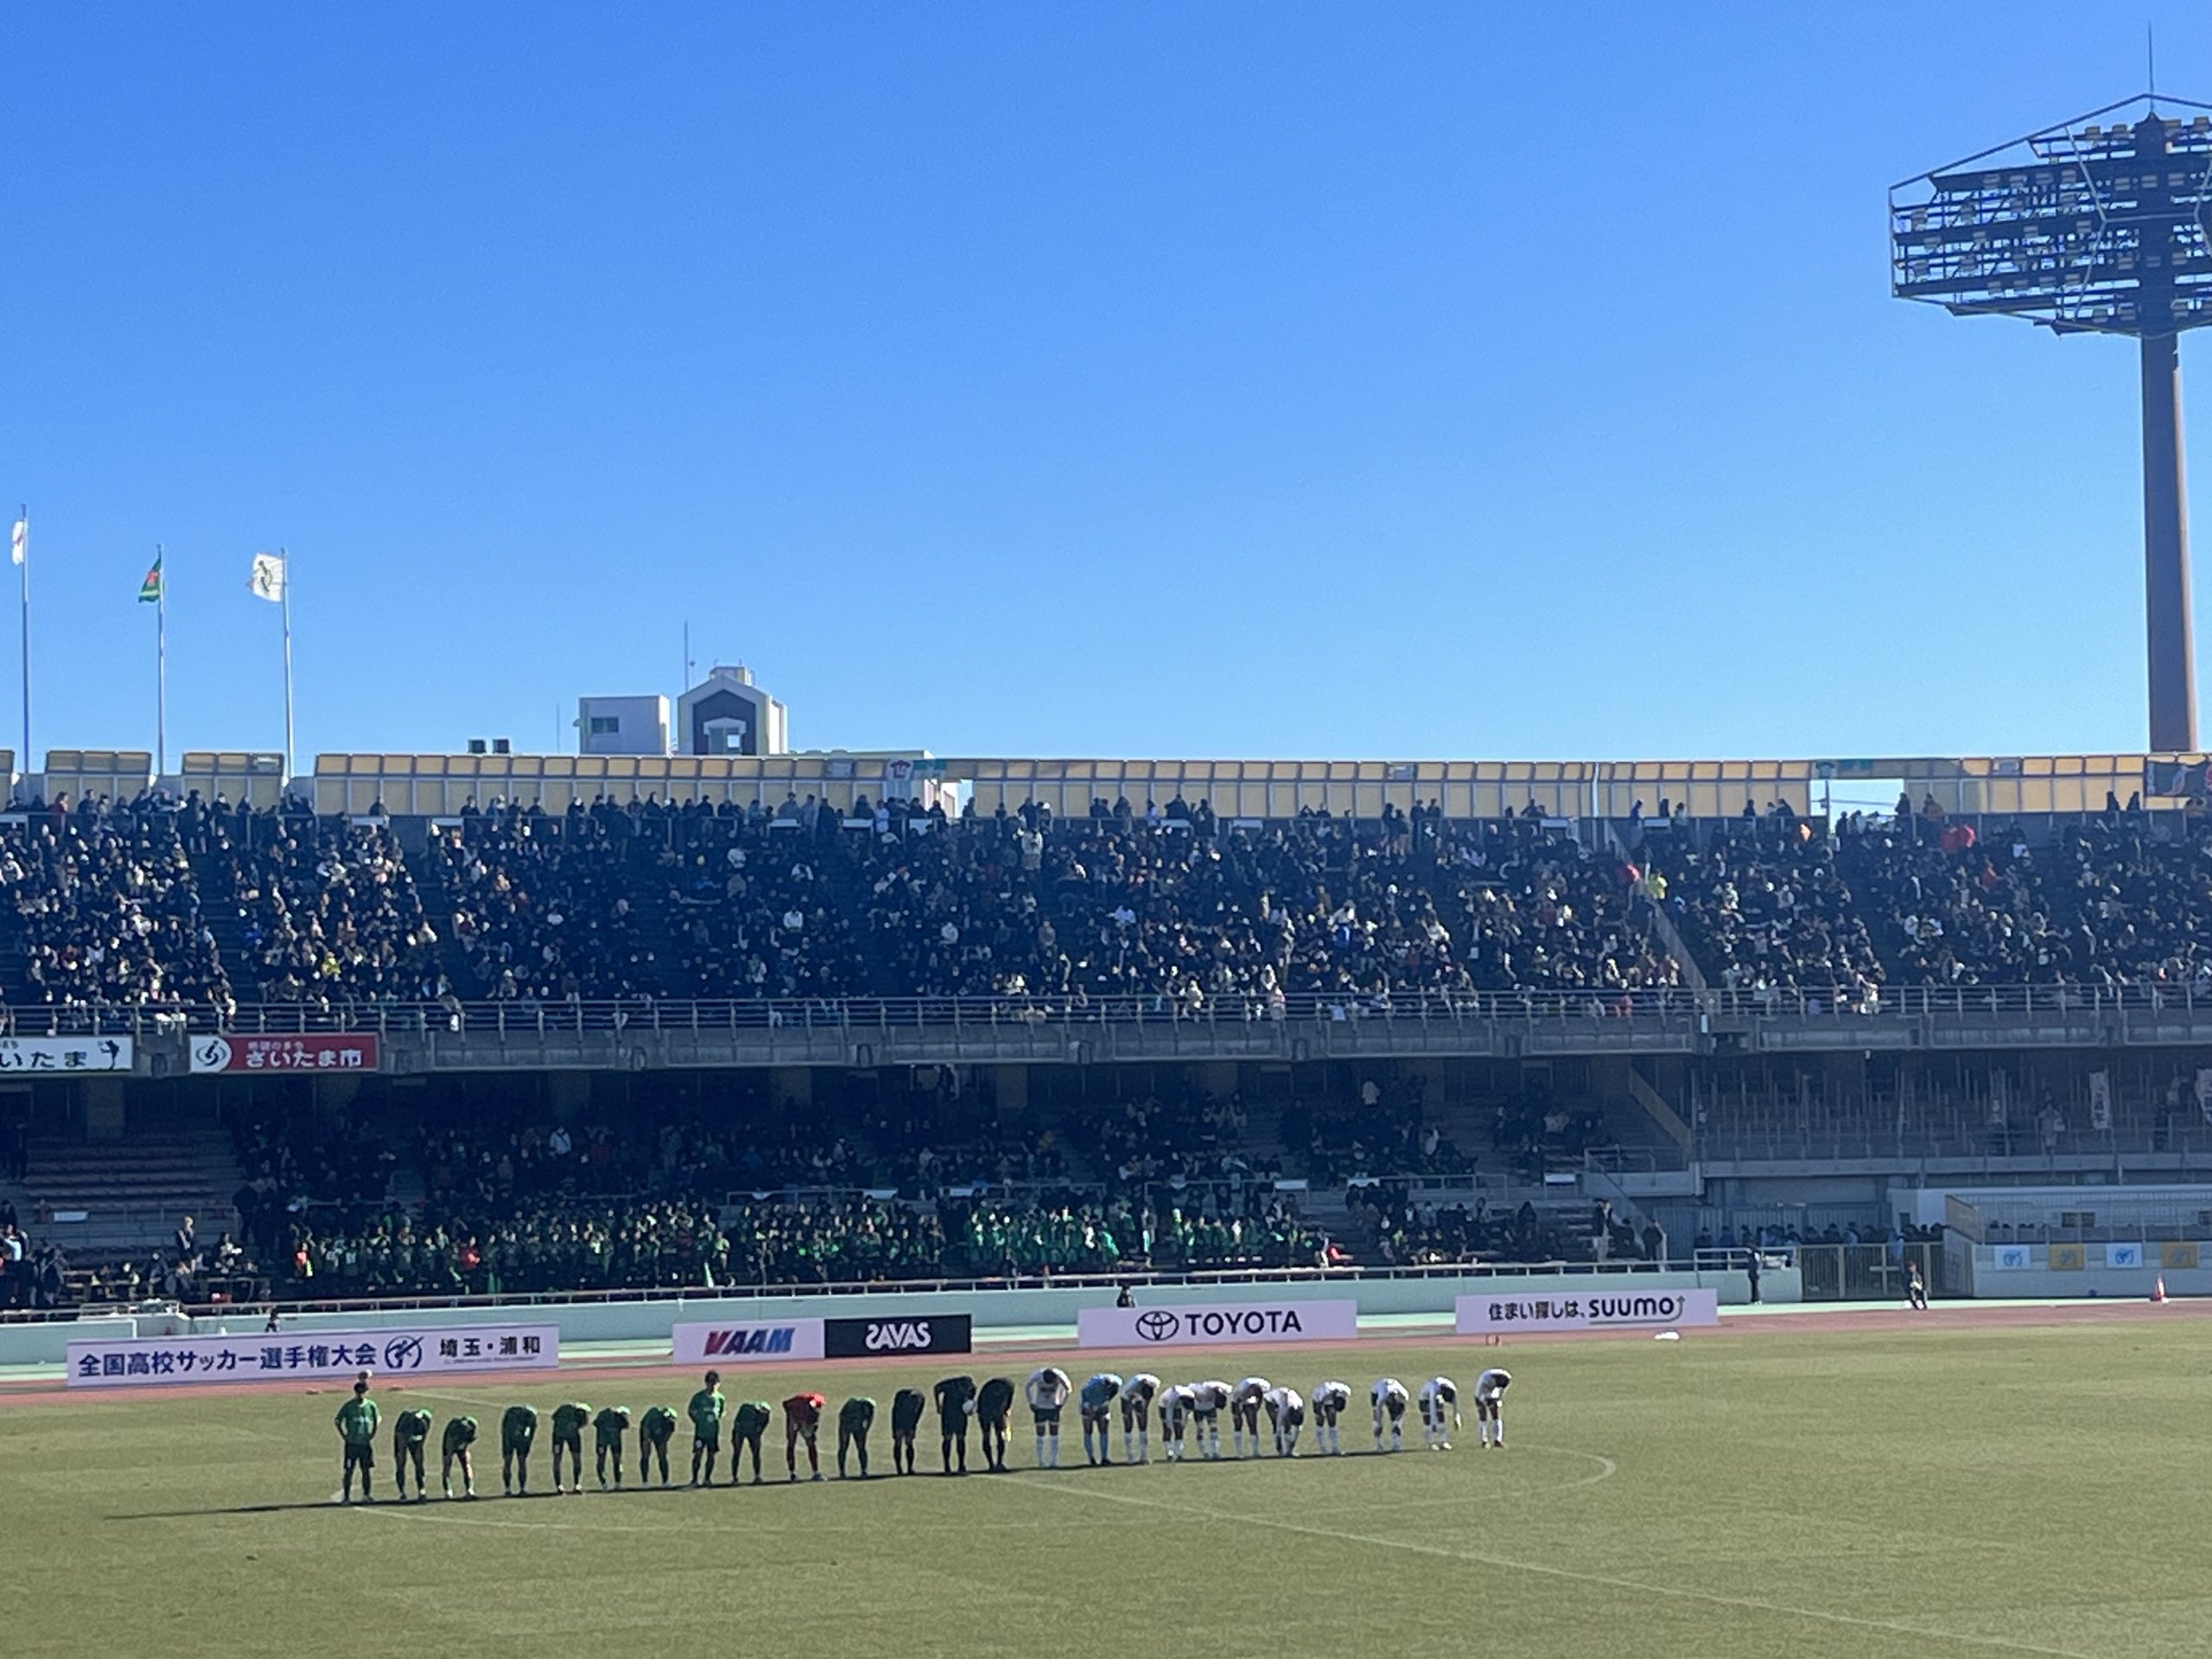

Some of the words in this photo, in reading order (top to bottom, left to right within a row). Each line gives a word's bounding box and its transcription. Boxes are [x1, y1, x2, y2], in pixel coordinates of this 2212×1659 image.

[246, 1049, 362, 1068] さいたま市
[866, 1322, 931, 1350] SAVAS
[1185, 1310, 1302, 1336] TOYOTA
[704, 1327, 795, 1357] VAAM
[79, 1343, 377, 1377] 全国高校サッカー選手権大会
[439, 1336, 541, 1358] 埼玉・浦和
